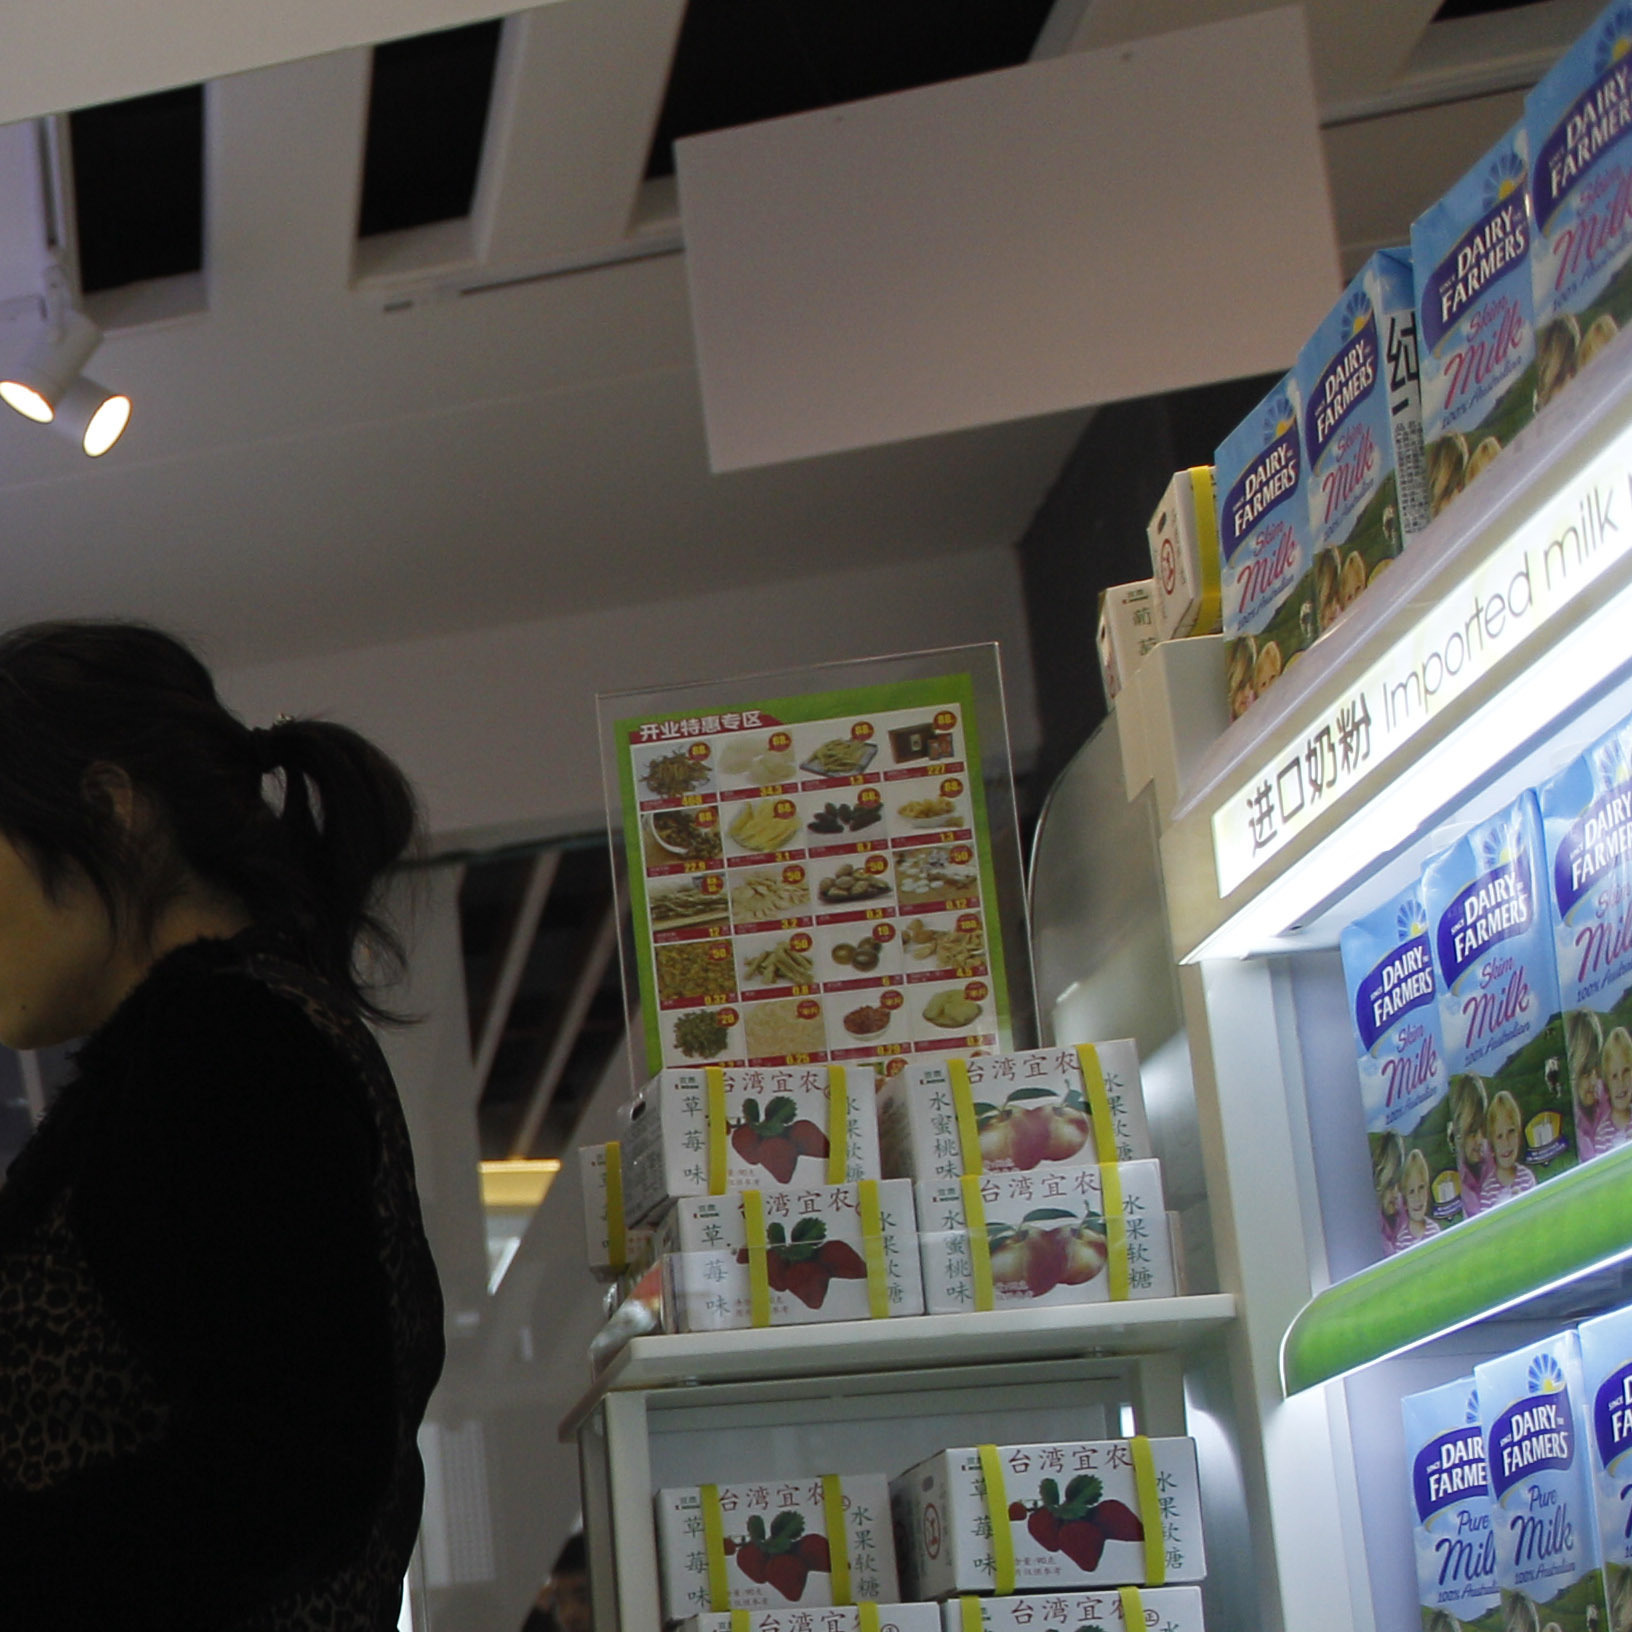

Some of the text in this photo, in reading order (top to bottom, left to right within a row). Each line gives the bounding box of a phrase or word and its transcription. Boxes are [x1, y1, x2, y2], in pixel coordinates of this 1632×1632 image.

[1456, 206, 1514, 278] DAIRY
[1441, 225, 1526, 323] FARMERS
[1317, 358, 1373, 443] FARMERS
[1325, 342, 1366, 401] DAIRY
[1234, 458, 1297, 538] FARMERS
[1246, 442, 1288, 499] DAIRY
[1247, 488, 1619, 858] 进口奶粉 Imported milk
[640, 710, 763, 741] 开业特惠专区
[1454, 895, 1528, 964] FARMERS
[1465, 872, 1516, 927] DAIRY
[1374, 967, 1433, 1028] FARMERS
[1383, 945, 1423, 994] DAIRY
[1463, 971, 1530, 1050] Milk
[1512, 1403, 1557, 1437] DAIRY
[1503, 1432, 1568, 1478] FARMERS
[1458, 1510, 1489, 1536] Pure
[1511, 1507, 1574, 1567] Milk
